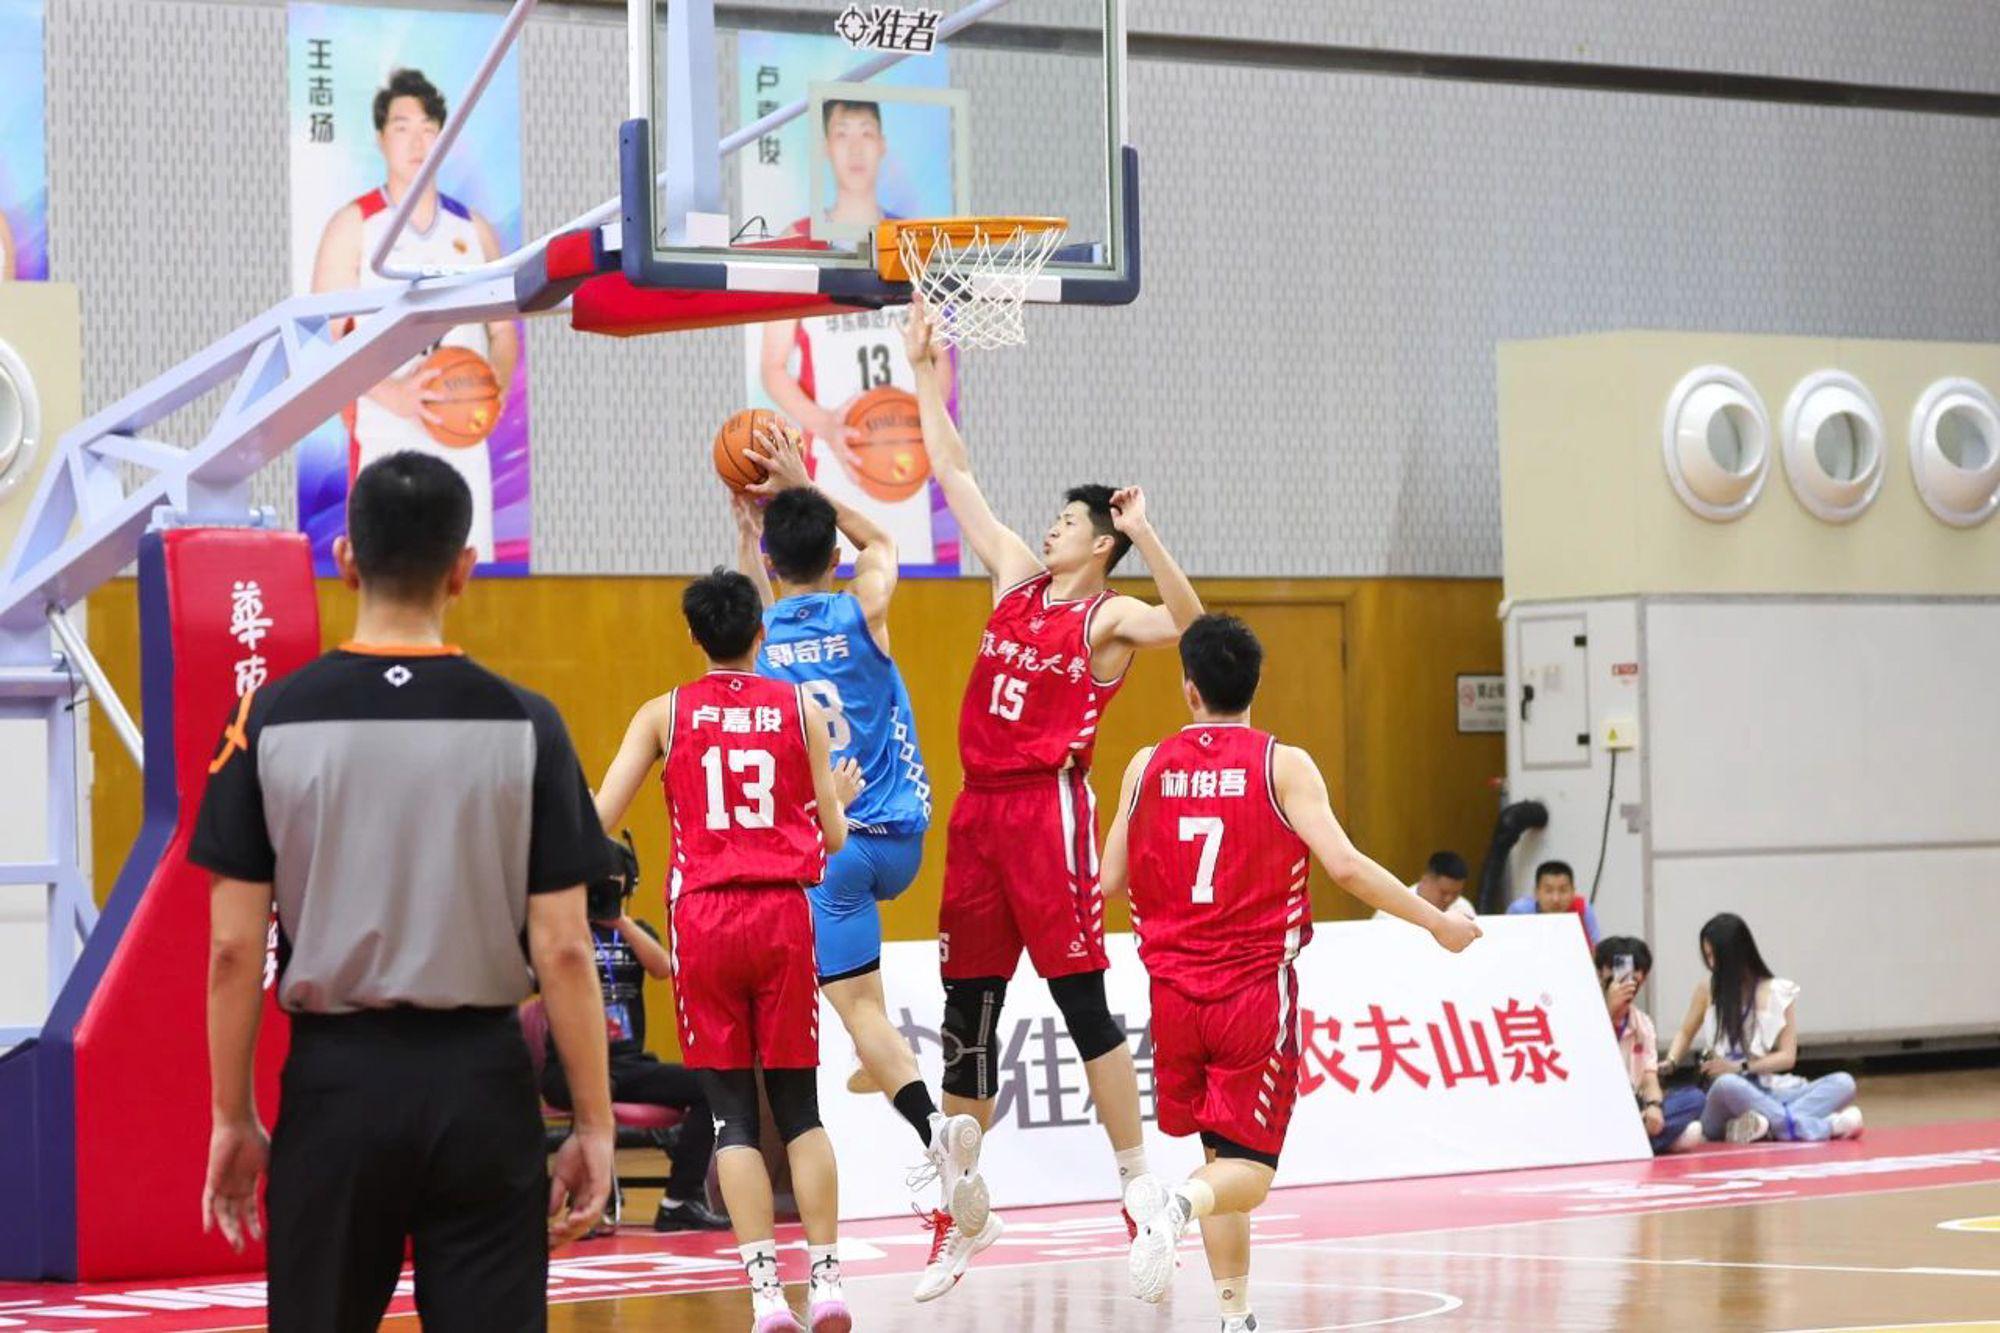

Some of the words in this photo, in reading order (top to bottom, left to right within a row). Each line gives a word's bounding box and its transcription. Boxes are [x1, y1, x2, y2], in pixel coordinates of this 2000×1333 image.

[867, 7, 938, 52] 准者
[308, 39, 334, 143] 王志扬
[857, 344, 891, 391] 13
[764, 633, 850, 669] 郭奇芳
[692, 704, 782, 733] 卢嘉俊
[988, 673, 1029, 721] 15
[701, 745, 776, 830] 13
[1160, 768, 1247, 798] 林俊吾
[1178, 816, 1224, 904] 7
[1300, 998, 1569, 1097] 农夫山泉
